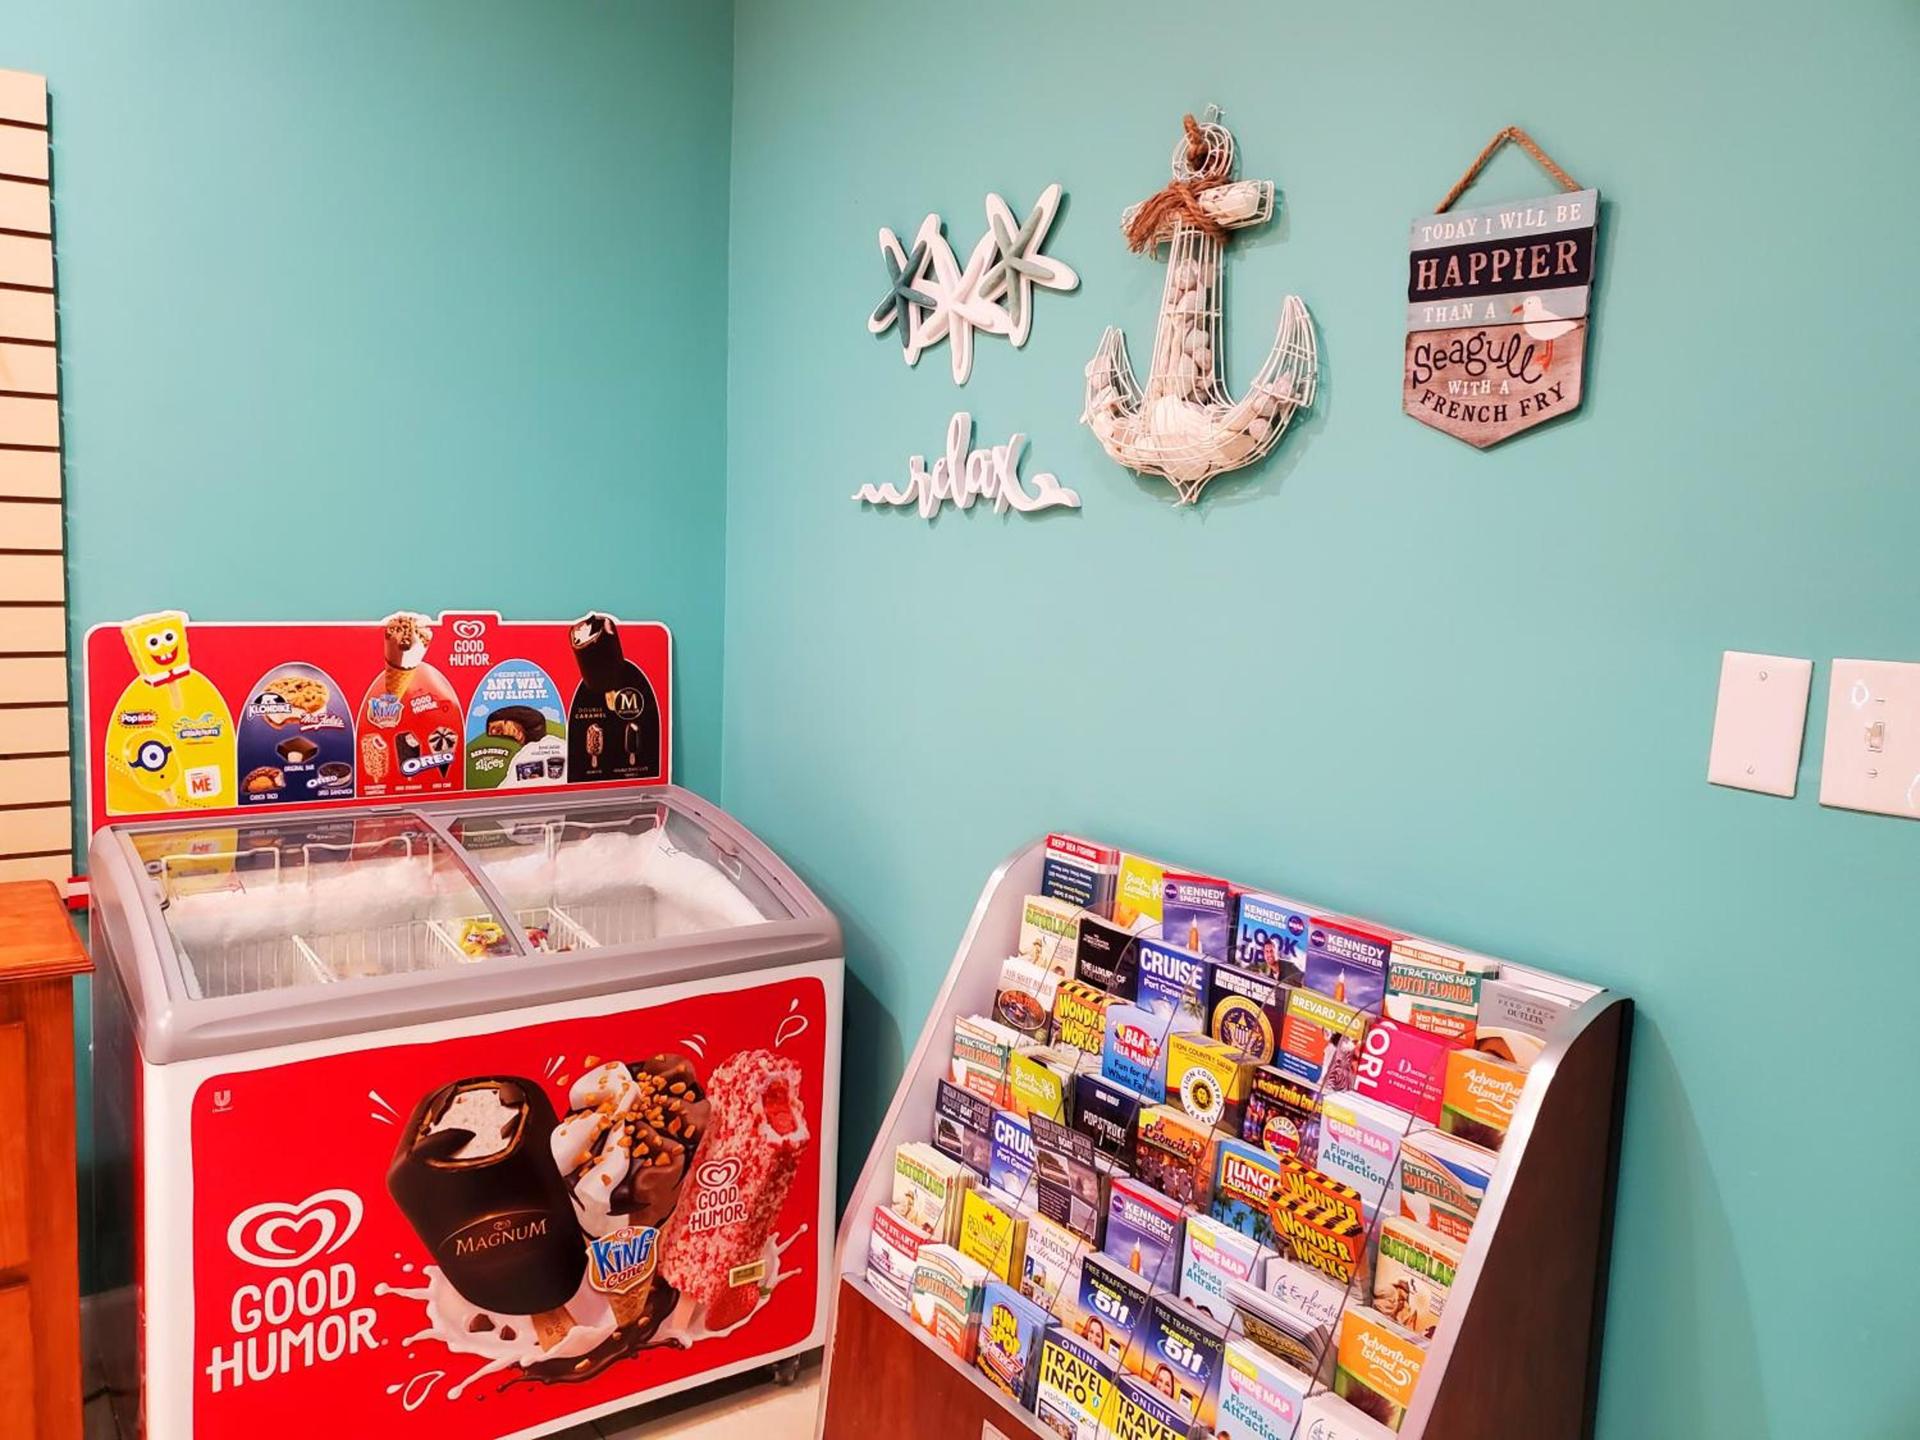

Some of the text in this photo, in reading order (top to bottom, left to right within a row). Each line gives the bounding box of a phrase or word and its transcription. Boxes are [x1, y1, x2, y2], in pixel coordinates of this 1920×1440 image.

[1422, 203, 1581, 243] TODAY I WILL BE
[1416, 240, 1578, 291] HAPPIER
[1424, 302, 1496, 323] THAN A
[1412, 331, 1542, 389] Seagull
[1448, 380, 1511, 396] WITH A
[1420, 382, 1566, 423] FRENCH FRY
[880, 412, 1045, 519] relax
[449, 653, 490, 666] HUMOR
[453, 639, 485, 653] GOOD
[482, 690, 505, 700] YOU
[505, 689, 535, 700] SLICE
[486, 676, 545, 690] ANY WAY
[248, 703, 292, 719] KLONDIKE
[620, 693, 638, 709] M
[402, 752, 455, 773] OREO
[191, 778, 213, 793] ME
[306, 775, 338, 788] OREO
[1180, 886, 1226, 900] KENNEDY
[1180, 895, 1226, 908] SPACE CENTER
[1244, 903, 1287, 923] KENNEDY
[1244, 912, 1287, 930] SPACE CENTER
[1242, 924, 1299, 958] LOOK
[1328, 934, 1385, 958] KENNEDY
[1140, 948, 1204, 990] CRUISE
[1326, 945, 1352, 959] SPACE
[1351, 952, 1384, 968] CENTER
[1116, 974, 1127, 983] OF
[1144, 978, 1160, 992] Port
[1391, 965, 1477, 987] ATTRACTIONS MAP
[1426, 981, 1473, 1003] FLORIDA
[1292, 995, 1361, 1029] BREVARD ZOO
[1506, 1009, 1544, 1025] OUTLETS
[1061, 1018, 1101, 1056] WORKS
[1115, 1060, 1129, 1071] Fun
[1130, 1064, 1142, 1075] for
[1353, 1028, 1391, 1091] ORL
[1108, 1066, 1133, 1083] Whole
[1464, 1068, 1525, 1097] Adventur
[1467, 1083, 1507, 1102] Island
[994, 1119, 1035, 1161] CRUIS
[1329, 1119, 1391, 1154] GUIDE MAP
[996, 1150, 1010, 1165] Port
[1330, 1142, 1366, 1166] Florida
[1227, 1160, 1279, 1189] JUNGL
[698, 1186, 738, 1210] GOOD
[1286, 1172, 1358, 1226] WONDER
[1124, 1200, 1174, 1235] KENNEDY
[1124, 1212, 1146, 1227] SPACE
[455, 1217, 548, 1258] MAGNUM
[1276, 1208, 1352, 1262] WONDER
[1192, 1261, 1222, 1287] Florida
[1221, 1254, 1246, 1275] MAP
[1290, 1236, 1350, 1285] WORKS
[1381, 1234, 1456, 1289] GATORLAN
[1085, 1262, 1147, 1304] FREE TRAFFIC INFO
[1090, 1279, 1122, 1302] FLORIDA
[230, 1262, 357, 1334] GOOD
[1094, 1290, 1129, 1325] 511
[991, 1305, 1018, 1338] FUN
[1155, 1306, 1225, 1353] FREE TRAFFIC INFO
[205, 1306, 381, 1394] HUMOR
[990, 1324, 1021, 1356] SPOT
[1160, 1324, 1196, 1351] FLORIDA
[1061, 1339, 1099, 1371] ONLINE
[1164, 1335, 1204, 1373] 511
[1359, 1332, 1421, 1371] Adventure
[1361, 1348, 1396, 1373] Island
[1045, 1344, 1104, 1398] TRAVEL
[1045, 1366, 1087, 1405] INFO
[1131, 1391, 1172, 1427] ONLINE
[1230, 1393, 1264, 1423] Florida
[1262, 1389, 1291, 1414] MAP
